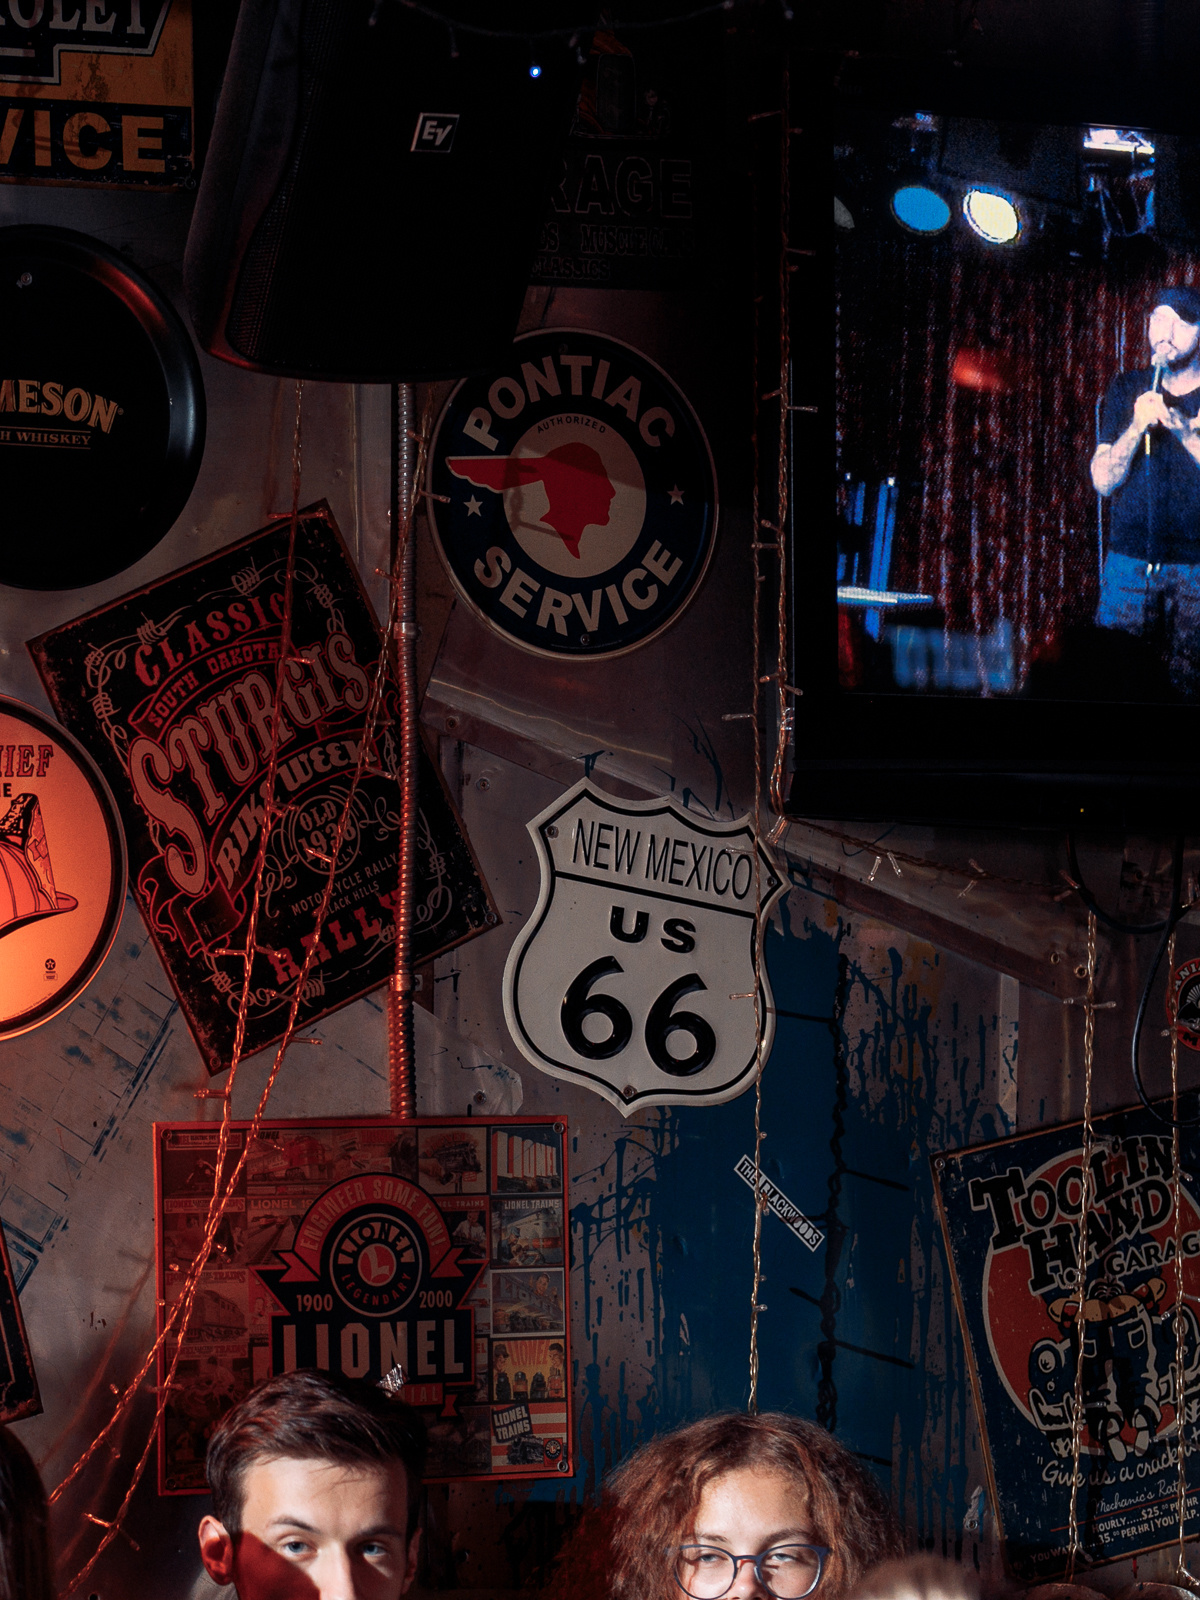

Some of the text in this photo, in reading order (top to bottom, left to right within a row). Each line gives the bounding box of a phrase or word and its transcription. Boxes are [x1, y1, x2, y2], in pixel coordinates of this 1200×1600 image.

[462, 354, 676, 452] PONTIAC
[16, 430, 92, 446] WHISKEY
[536, 415, 607, 435] AUTHORIZED
[473, 539, 684, 637] SERVICE
[133, 591, 290, 688] CLASSIC
[148, 641, 285, 728] SOUTH DAKOTA
[129, 631, 371, 895] STURGIS
[276, 739, 378, 792] WEEK
[299, 800, 338, 832] OLD
[320, 845, 355, 869] RLLY
[363, 852, 399, 879] RALLY
[572, 818, 752, 900] NEW MEXICO
[325, 880, 380, 916] LACK HILLS
[560, 955, 717, 1077] 66
[251, 1199, 297, 1210] LIONEL
[300, 1178, 448, 1251] ENGINEER SOME FUN!
[456, 1200, 485, 1208] TRAINS
[504, 1199, 560, 1210] LIONEL TRAINS
[760, 1182, 820, 1246] BLACKWOODS
[970, 1150, 1124, 1250] TOOL
[337, 1221, 416, 1265] LIONEL
[1021, 1179, 1171, 1292] HAND
[296, 1289, 453, 1313] 1900 2000
[340, 1271, 412, 1307] LEGENDARY
[282, 1319, 465, 1380] LIONEL
[507, 1339, 550, 1366] LIONEL
[492, 1405, 528, 1427] LIONEL
[495, 1420, 531, 1441] TRAINS
[1136, 1437, 1180, 1479] crack
[1092, 1487, 1156, 1515] Mechanic's
[1155, 1478, 1192, 1498] Rat
[1120, 1526, 1138, 1539] PER
[1137, 1522, 1150, 1535] HR
[1154, 1515, 1175, 1529] YOU
